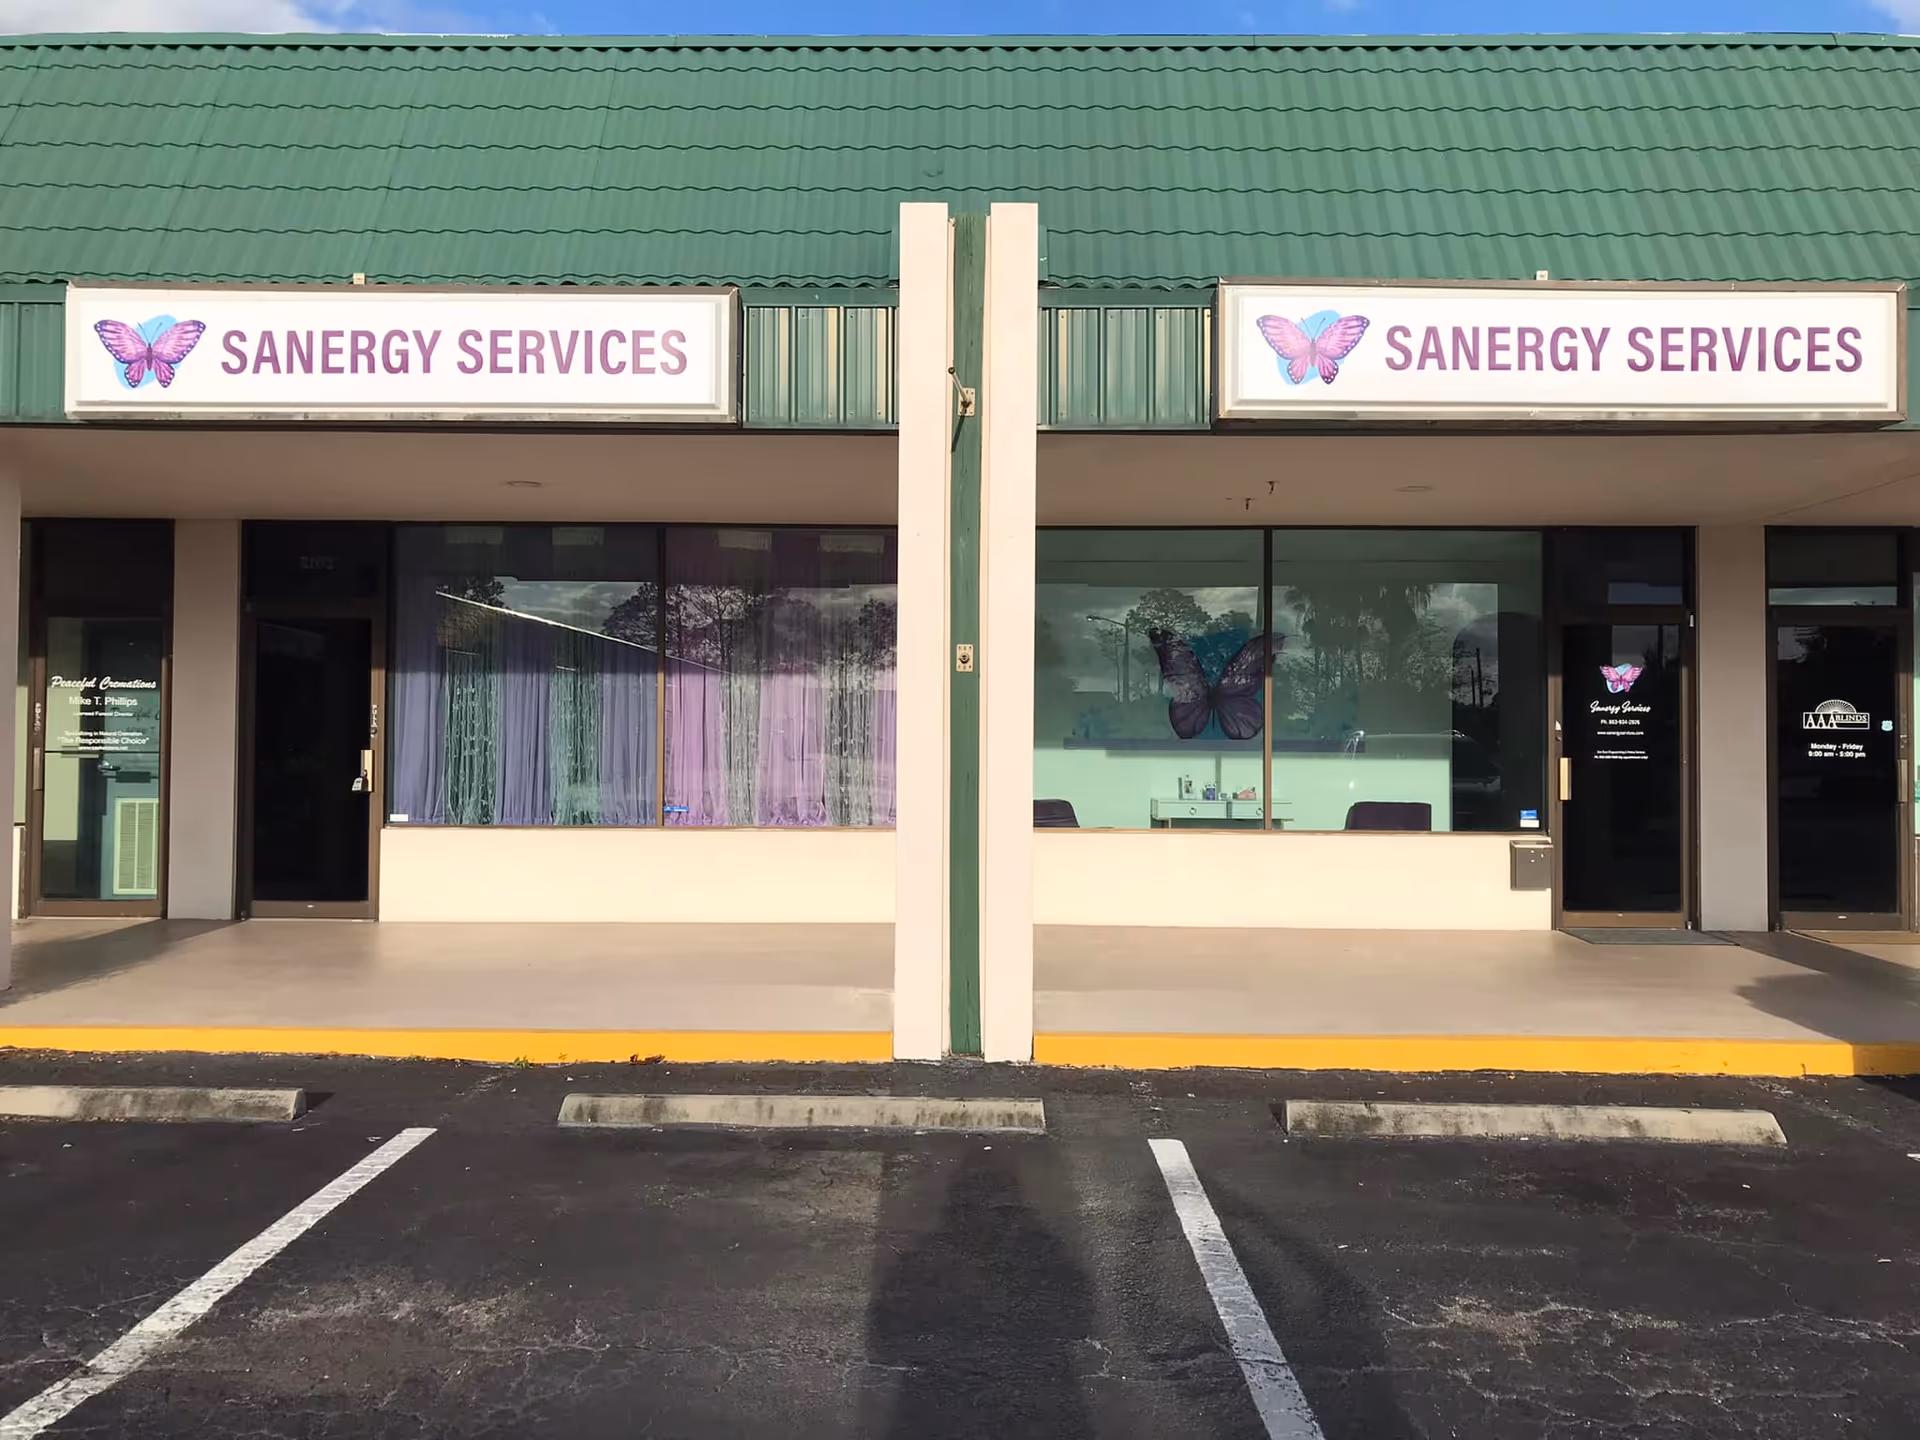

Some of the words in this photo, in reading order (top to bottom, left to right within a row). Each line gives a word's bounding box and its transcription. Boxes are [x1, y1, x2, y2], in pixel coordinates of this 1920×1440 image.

[221, 328, 441, 376] SANERGY
[456, 329, 688, 376] SERVICES
[1385, 324, 1611, 372] SANERGY
[1626, 325, 1864, 373] SERVICES
[50, 675, 97, 691] Peaceful
[99, 676, 157, 690] Cremations
[68, 696, 92, 706] Mike
[93, 696, 103, 706] T.
[104, 696, 138, 708] Phillips
[1590, 700, 1620, 714] Sanergy
[1621, 700, 1651, 714] Services
[1805, 713, 1838, 728] AAA
[1835, 714, 1868, 722] BLINDS
[75, 737, 120, 746] Responsible
[120, 737, 149, 745] Choice"
[1810, 743, 1837, 751] Monday
[1842, 743, 1864, 751] Friday
